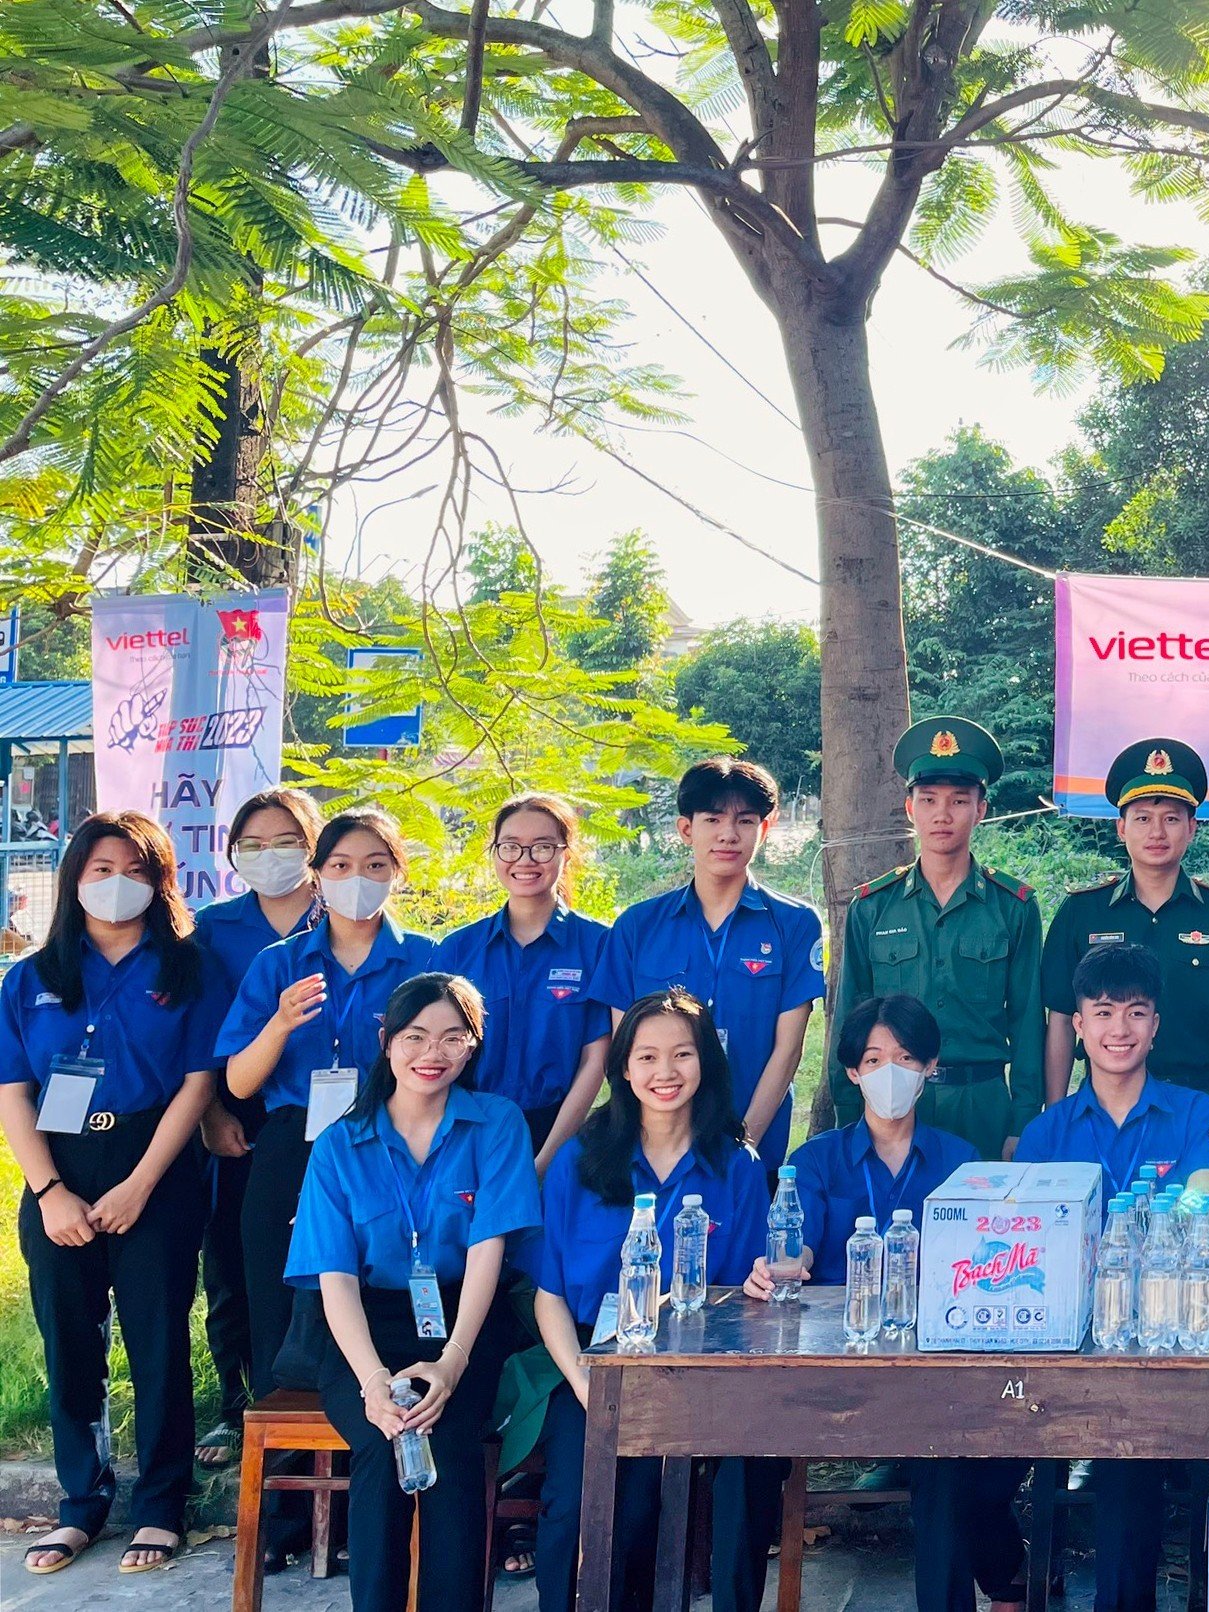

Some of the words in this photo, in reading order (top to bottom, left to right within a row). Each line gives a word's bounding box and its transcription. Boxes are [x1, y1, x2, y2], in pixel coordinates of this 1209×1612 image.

[105, 628, 190, 651] viettel
[1128, 671, 1158, 683] Theo
[1160, 671, 1189, 683] cách
[202, 710, 262, 746] 2023
[151, 773, 223, 808] HÃY
[932, 1206, 969, 1222] 500ML
[976, 1215, 1042, 1235] 2023
[1001, 1380, 1026, 1400] A1
